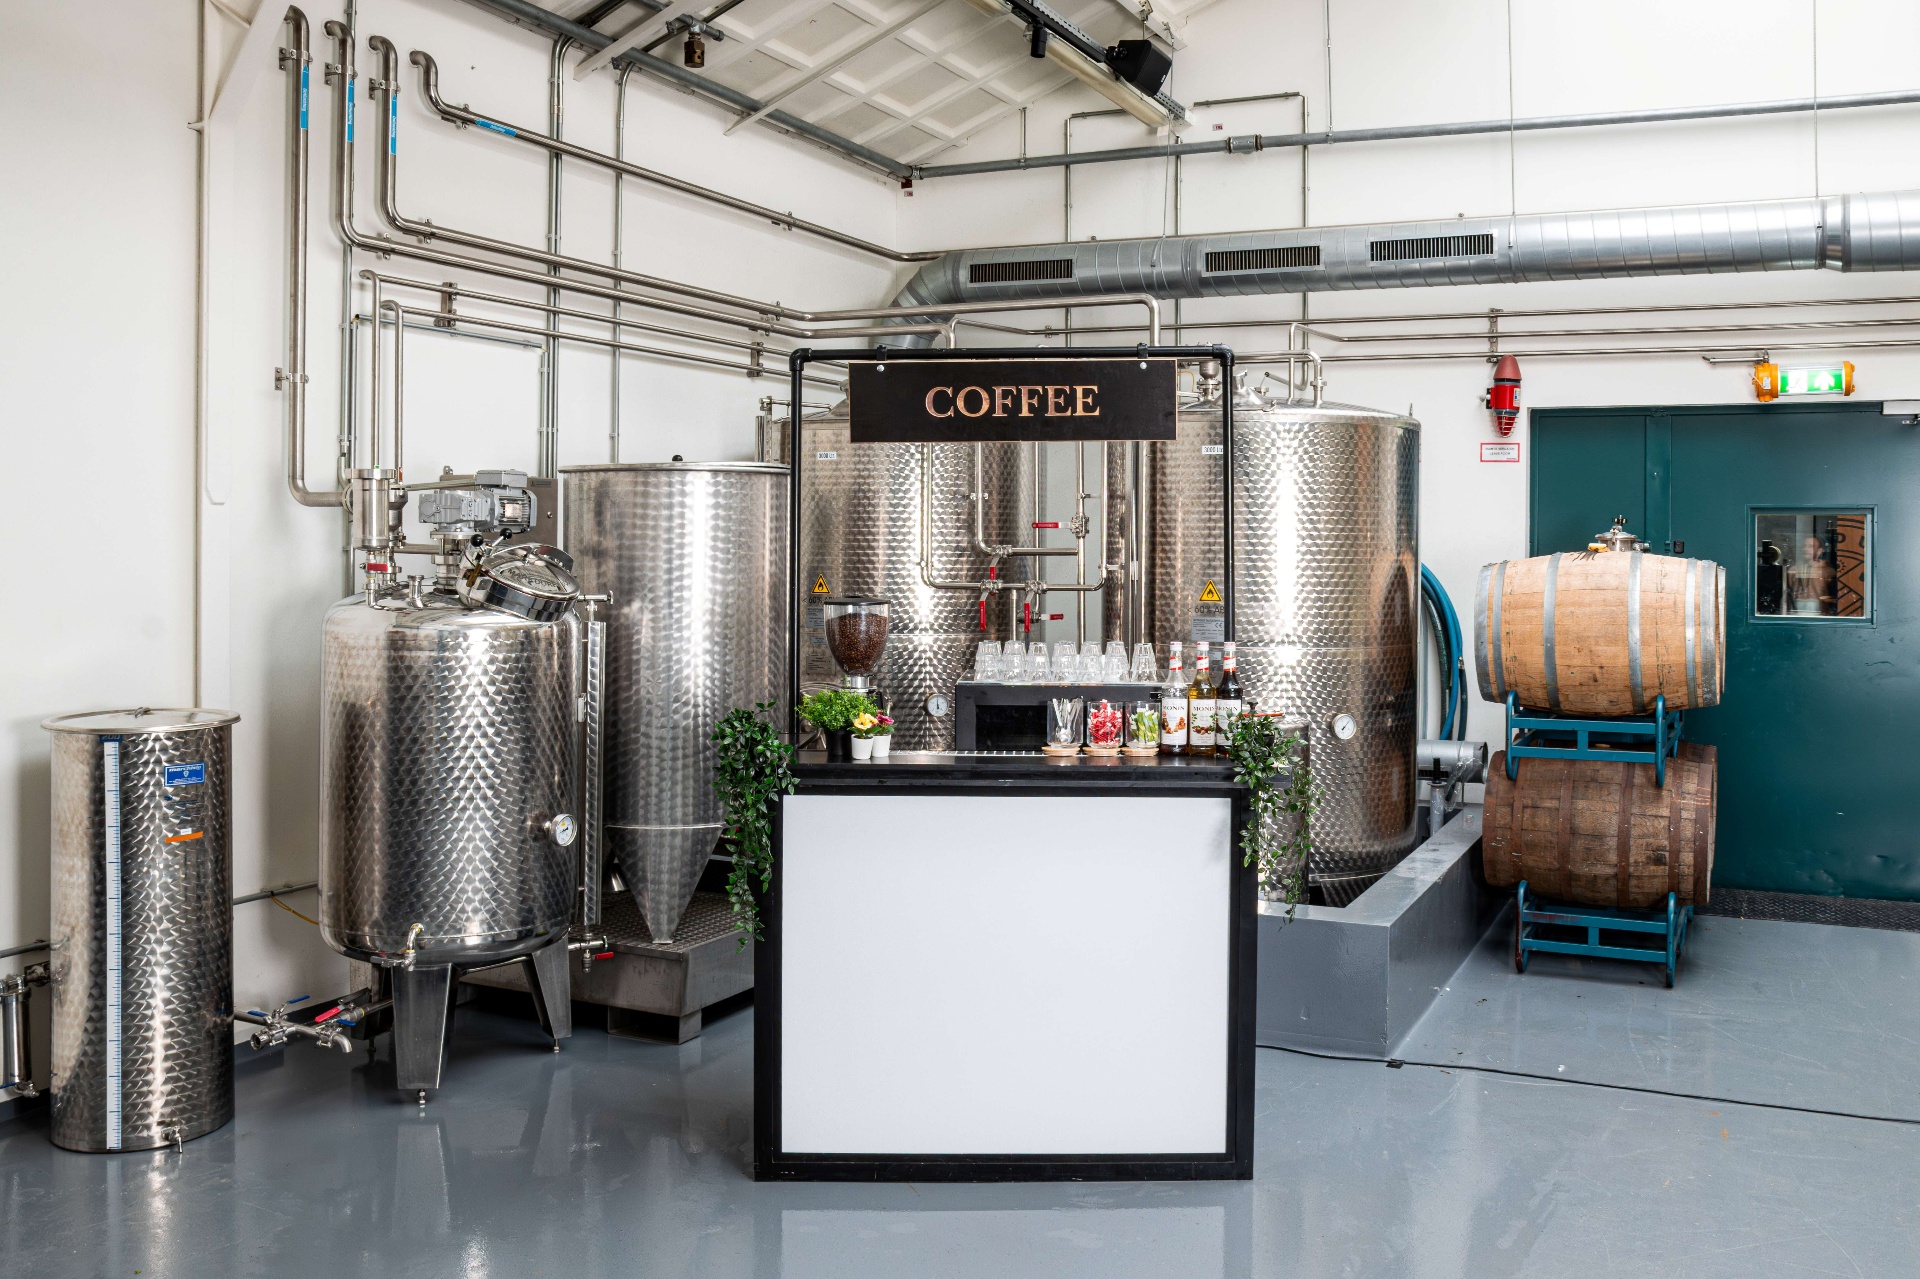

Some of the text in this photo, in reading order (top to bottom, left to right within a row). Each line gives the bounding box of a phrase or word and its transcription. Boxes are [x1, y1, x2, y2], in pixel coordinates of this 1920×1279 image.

[925, 385, 1100, 418] COFFEE
[808, 596, 823, 604] 60%
[1194, 605, 1211, 614] 60%
[1214, 605, 1225, 614] AB
